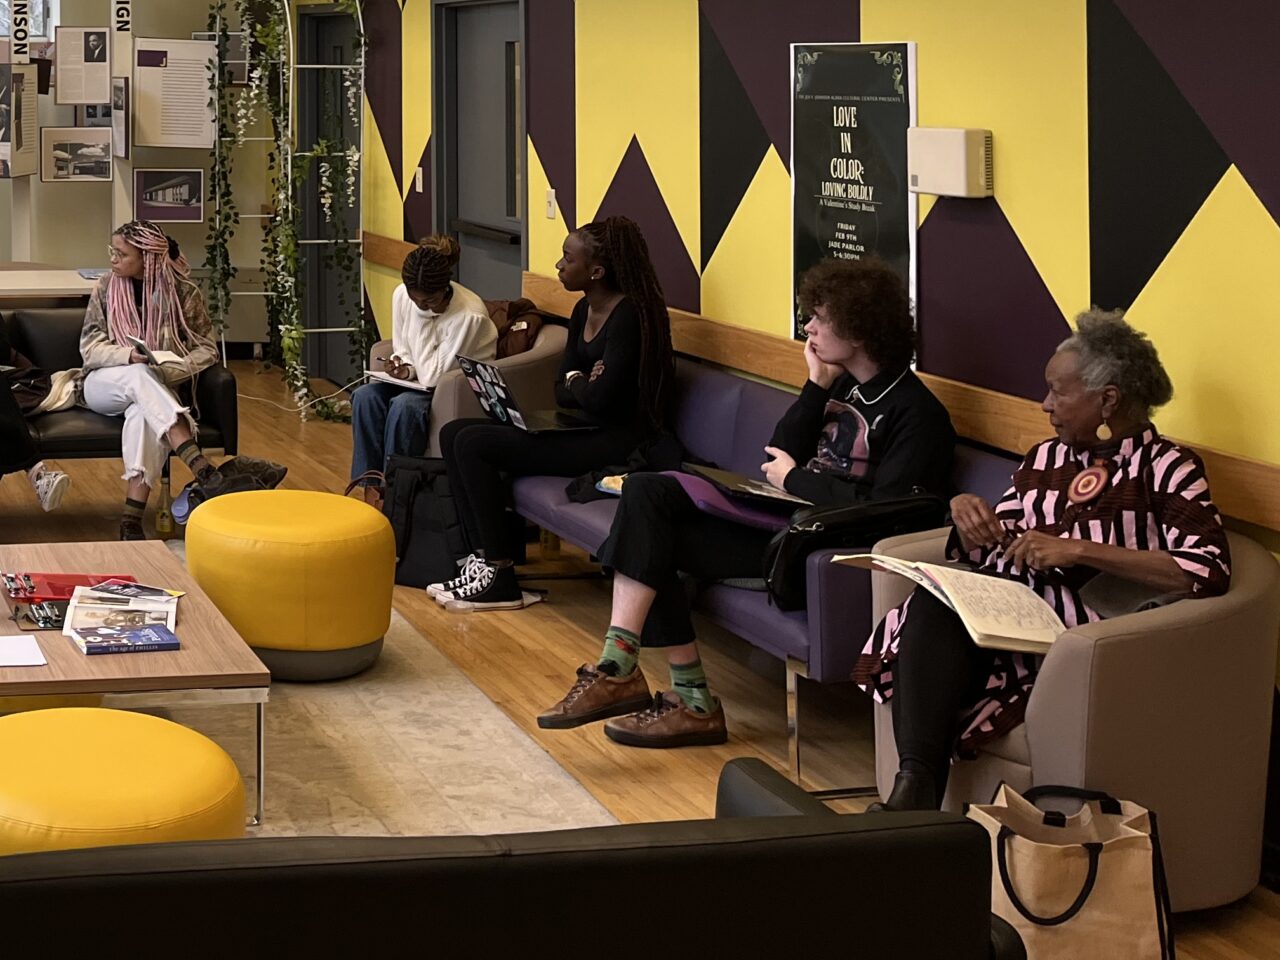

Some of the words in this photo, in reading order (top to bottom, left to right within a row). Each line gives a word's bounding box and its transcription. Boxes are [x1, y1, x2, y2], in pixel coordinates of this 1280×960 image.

[833, 106, 857, 128] LOVE
[840, 132, 852, 154] IN
[830, 158, 864, 184] COLOR:
[821, 181, 846, 198] LOVING
[848, 184, 874, 201] BOLDLY
[835, 232, 845, 240] FEB
[846, 233, 857, 241] 9TH
[837, 222, 856, 231] FRIDAY
[842, 242, 865, 252] PARLOR
